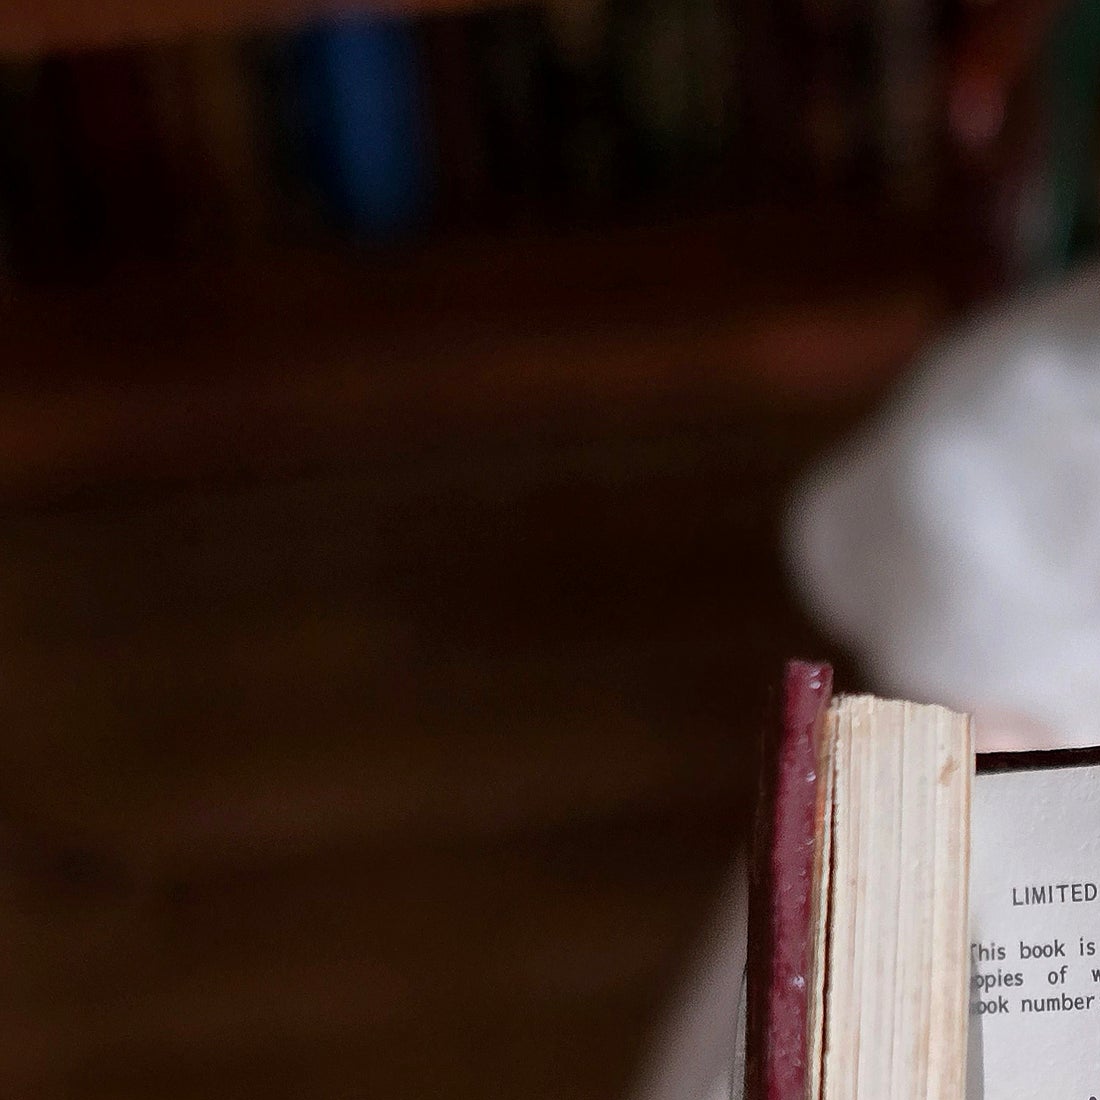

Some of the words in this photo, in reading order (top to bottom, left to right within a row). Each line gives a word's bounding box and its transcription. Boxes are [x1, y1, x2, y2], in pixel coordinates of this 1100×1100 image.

[1012, 883, 1098, 906] LIMITED
[1019, 941, 1066, 960] book
[1079, 936, 1096, 956] is
[972, 968, 1024, 993] opies
[1047, 965, 1069, 985] of
[973, 995, 1010, 1015] ook
